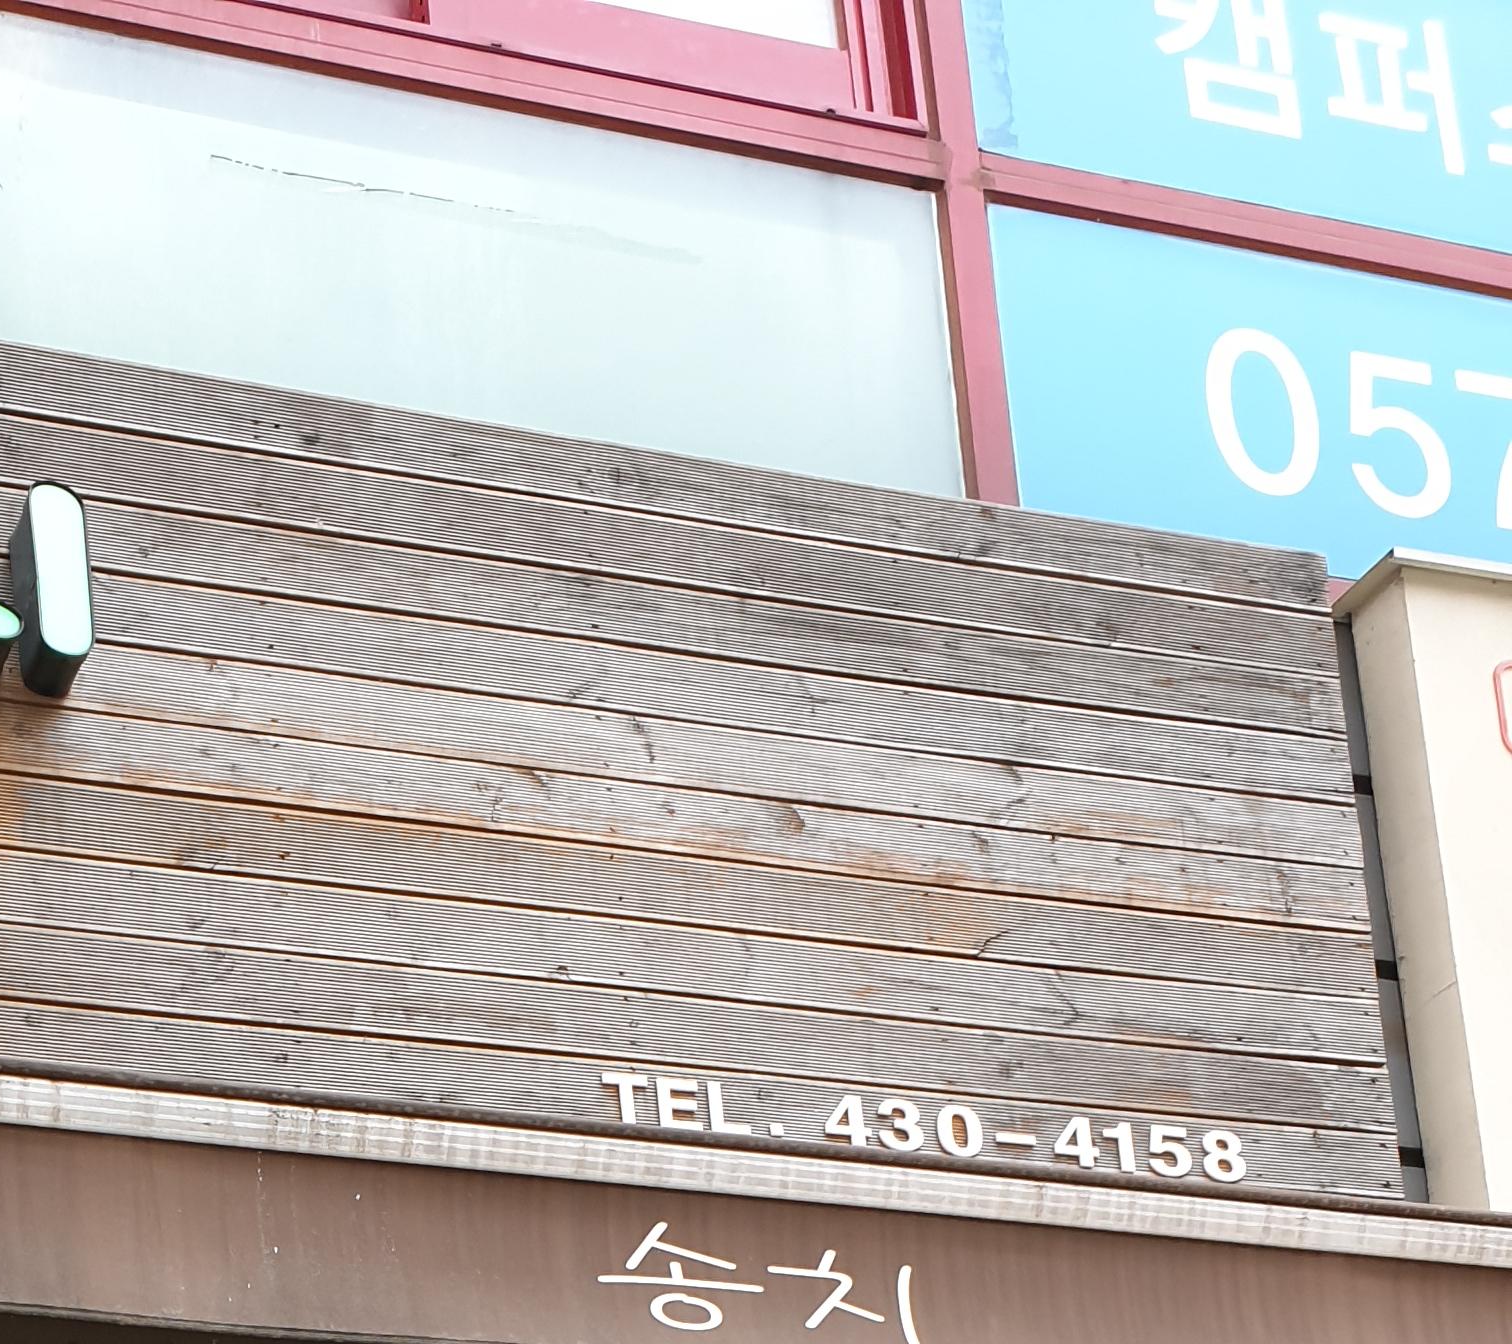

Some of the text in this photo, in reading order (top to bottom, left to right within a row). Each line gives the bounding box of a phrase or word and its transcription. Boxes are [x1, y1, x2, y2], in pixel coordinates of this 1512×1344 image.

[1155, 0, 1512, 175] 캠퍼
[600, 1070, 1248, 1185] TEL. 430-4158
